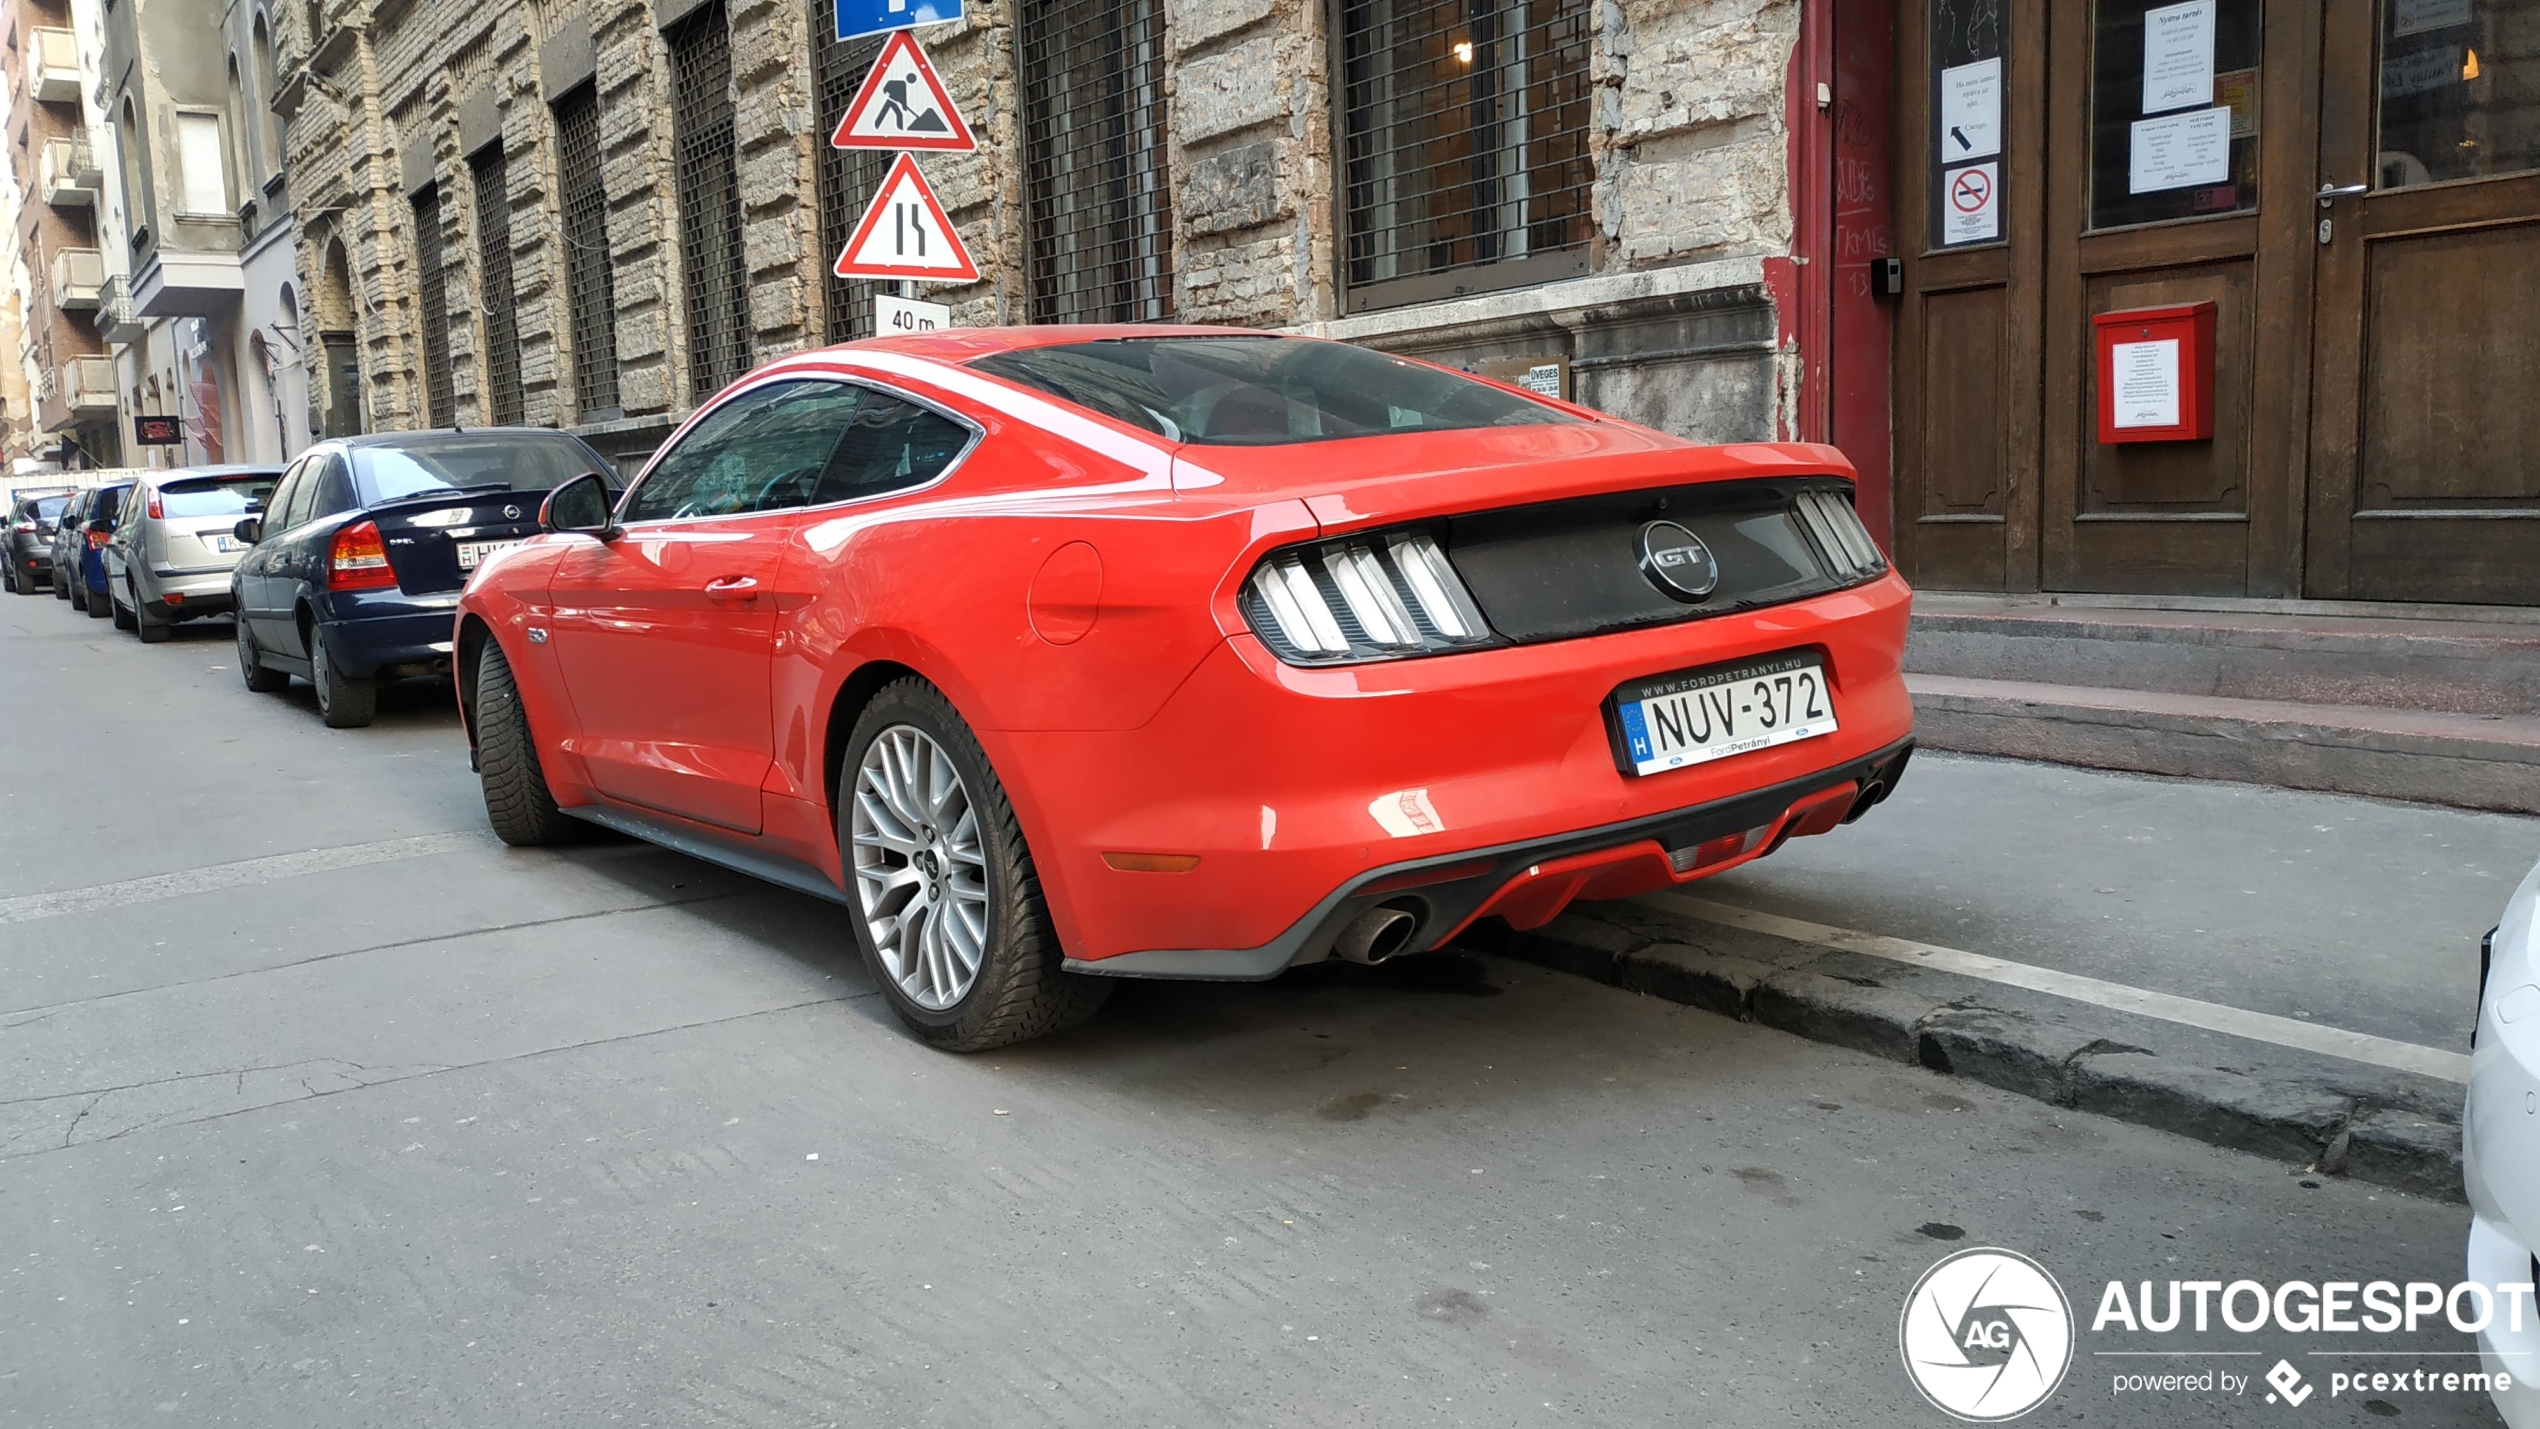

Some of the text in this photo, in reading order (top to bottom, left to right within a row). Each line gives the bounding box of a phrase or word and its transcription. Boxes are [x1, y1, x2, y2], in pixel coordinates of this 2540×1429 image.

[892, 310, 935, 331] 40 m
[1530, 367, 1558, 380] ÜVEGES
[1654, 545, 1701, 567] GT
[1641, 658, 1802, 698] WWW.FORDPETRANYI.HU
[1652, 672, 1823, 752] NUV-372
[1633, 736, 1648, 757] H
